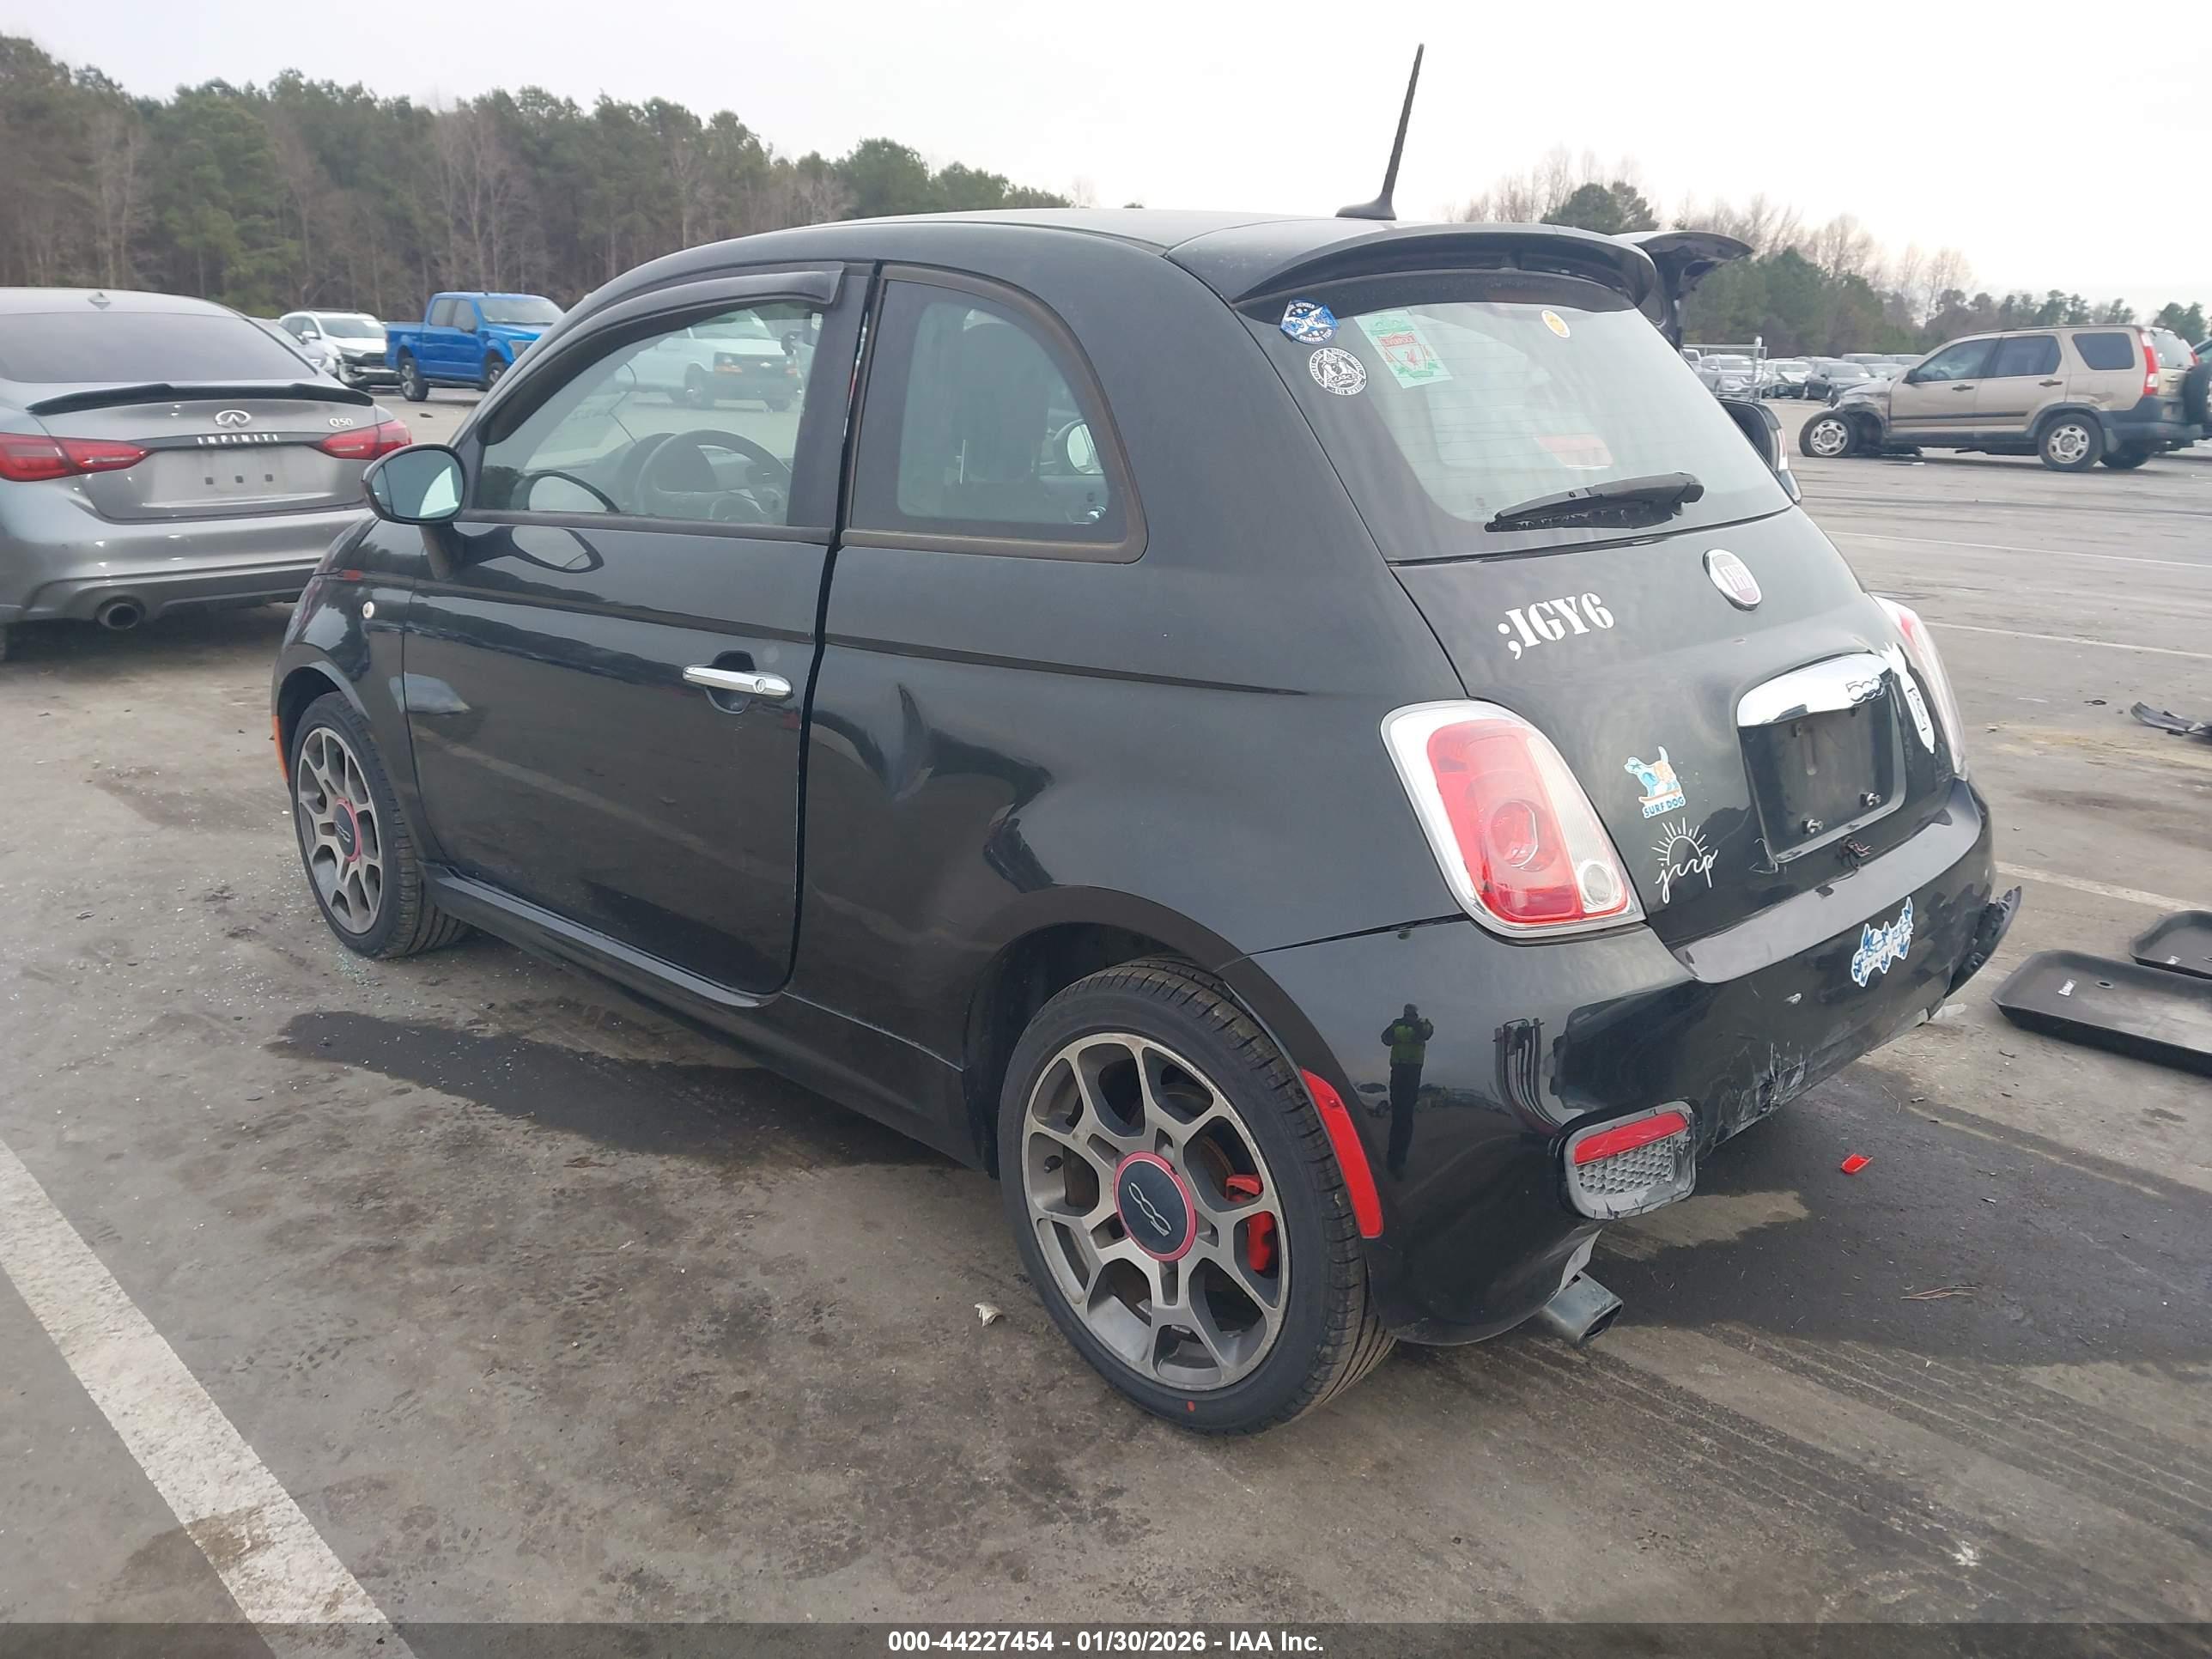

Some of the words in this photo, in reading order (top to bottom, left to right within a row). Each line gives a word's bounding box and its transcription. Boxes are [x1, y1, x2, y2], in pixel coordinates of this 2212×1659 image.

[329, 417, 353, 427] Q50
[198, 433, 278, 445] INFINITI
[1498, 592, 1614, 660] ;IGY6
[1845, 677, 1885, 702] 500
[1644, 802, 1665, 817] SURF
[1666, 796, 1685, 809] DOG
